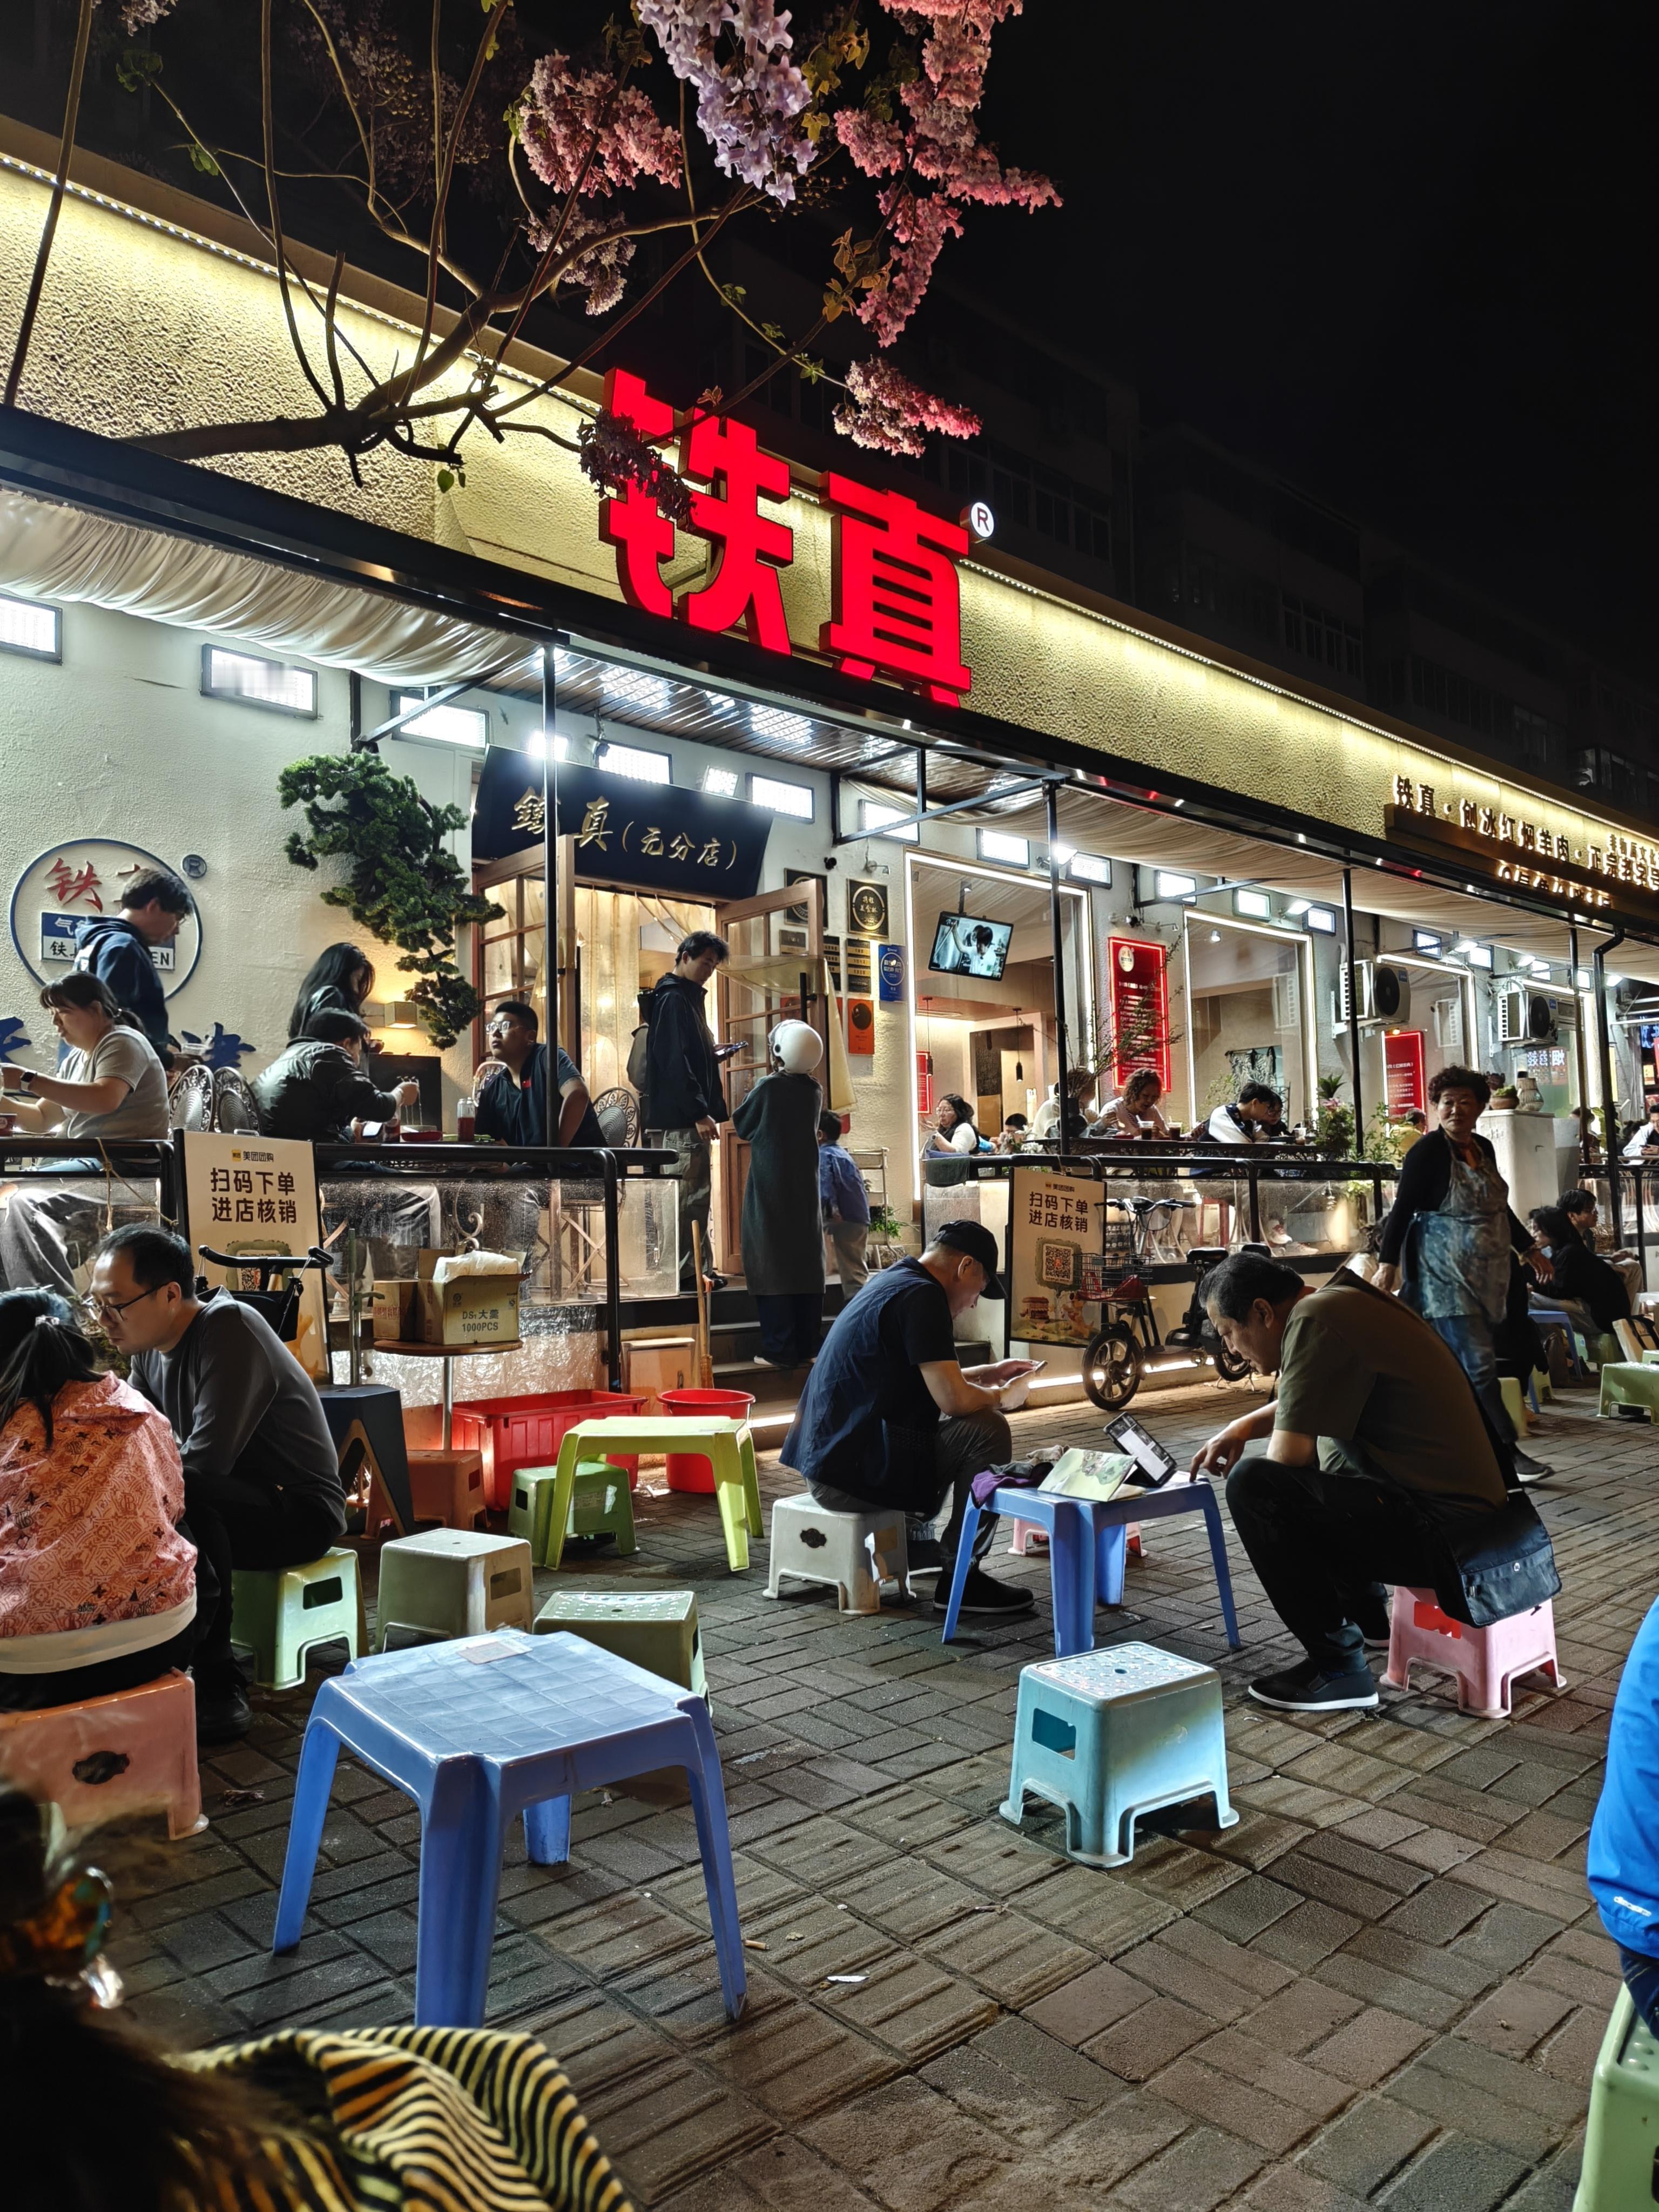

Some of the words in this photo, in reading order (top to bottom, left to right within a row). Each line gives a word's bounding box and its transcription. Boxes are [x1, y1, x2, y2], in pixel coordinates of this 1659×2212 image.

[599, 367, 972, 709] 铁真
[243, 1151, 274, 1162] 美团团购
[210, 1168, 295, 1196] 扫码下单
[212, 1197, 296, 1224] 进店核销
[1029, 1191, 1088, 1215] 扫码下单
[1029, 1209, 1088, 1233] 进店核销
[462, 1321, 498, 1332] 1000PCS
